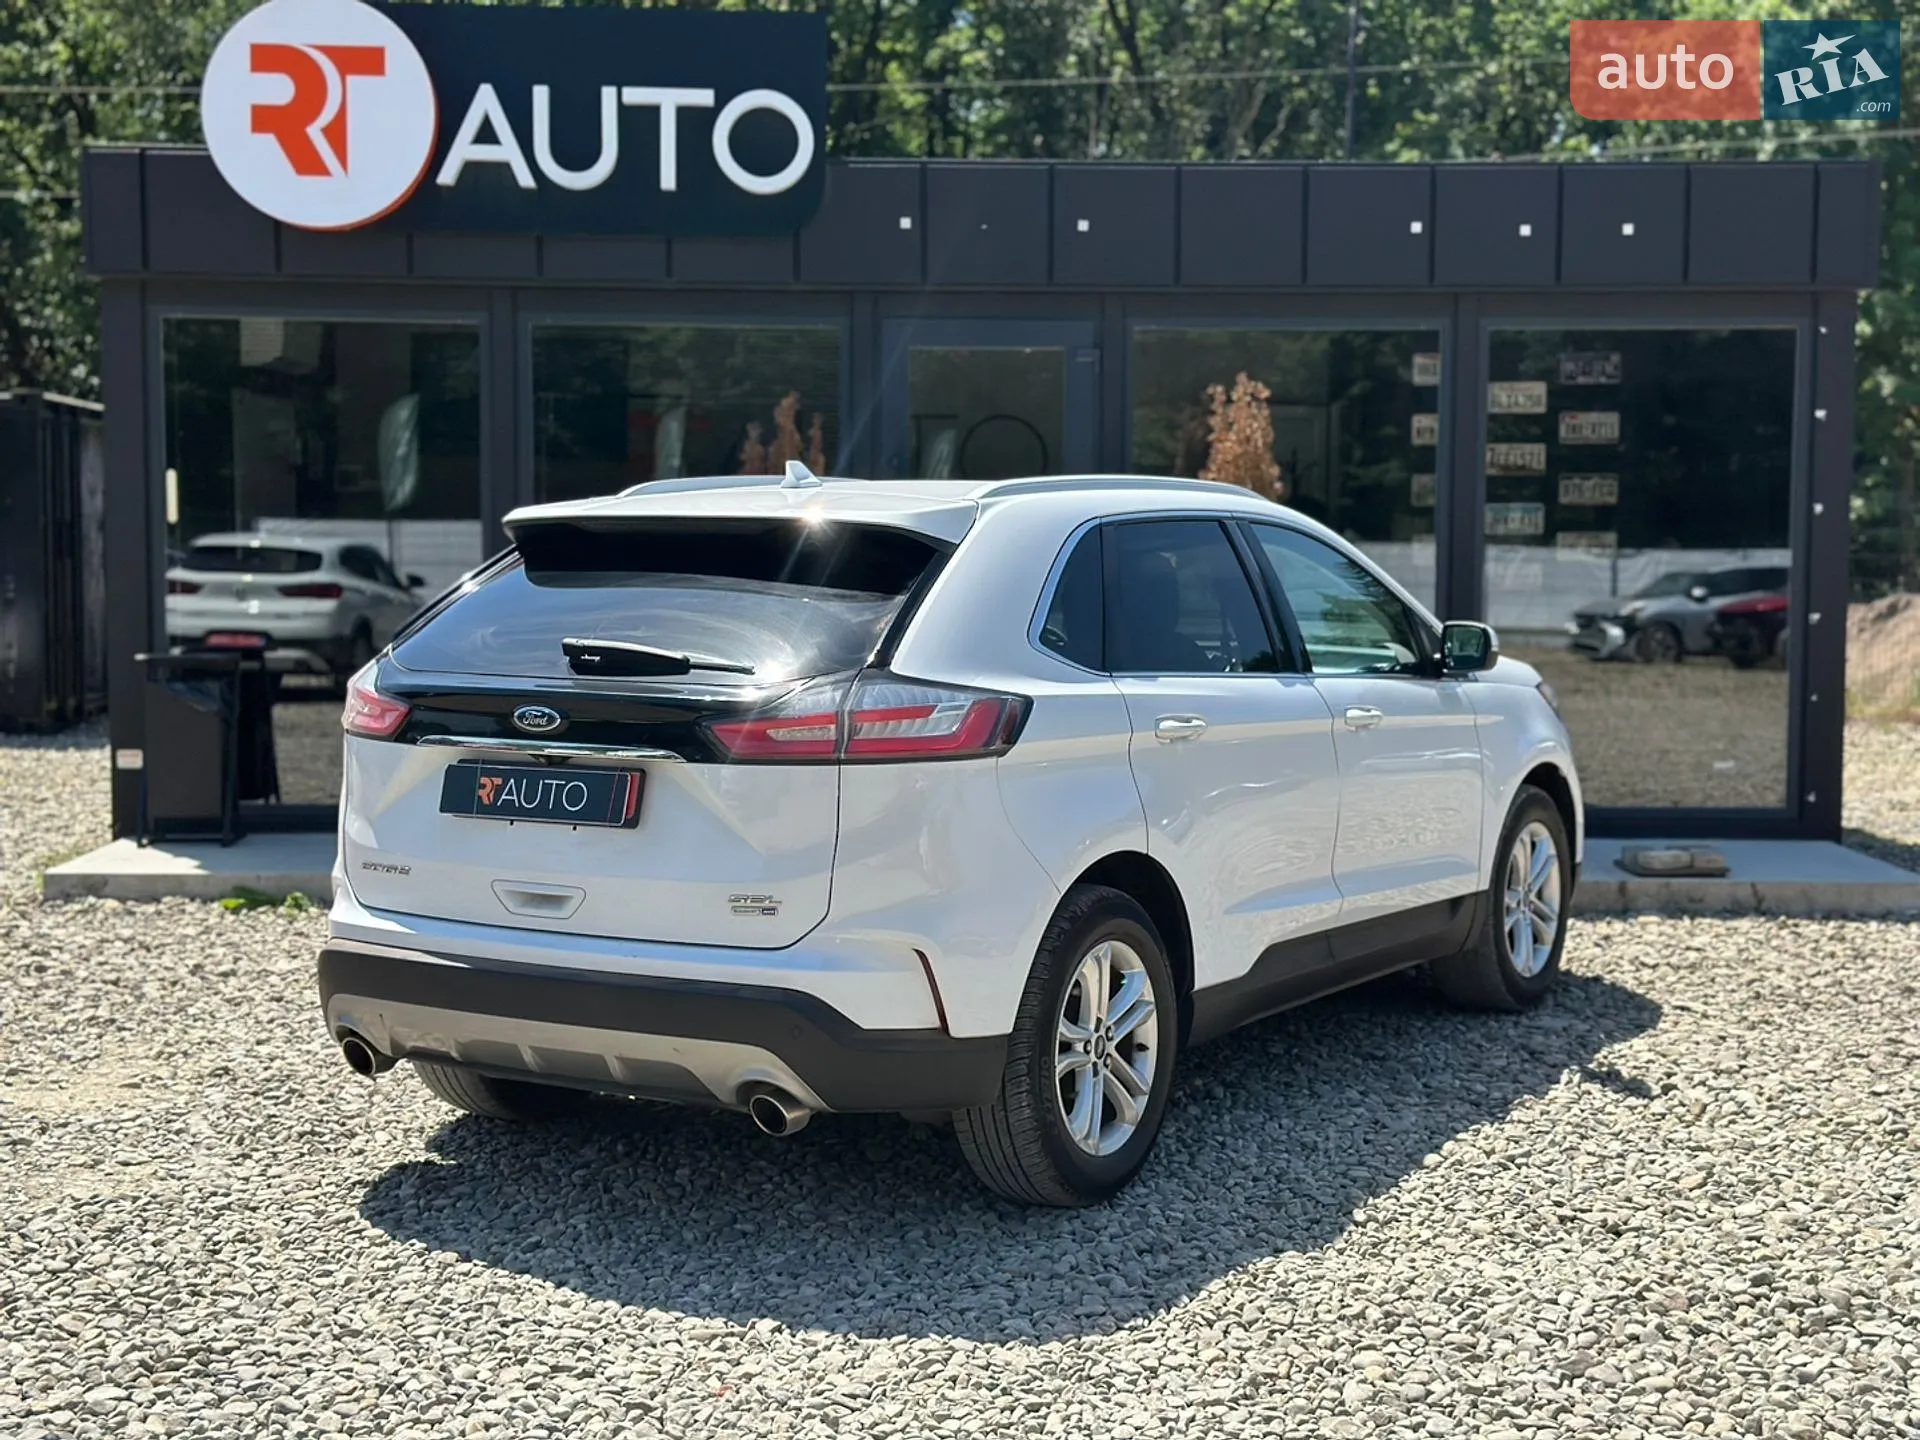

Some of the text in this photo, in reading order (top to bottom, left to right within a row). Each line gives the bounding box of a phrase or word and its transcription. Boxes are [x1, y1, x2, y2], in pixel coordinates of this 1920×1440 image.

[250, 43, 815, 195] RT AUTO
[478, 776, 588, 812] RT AUTO
